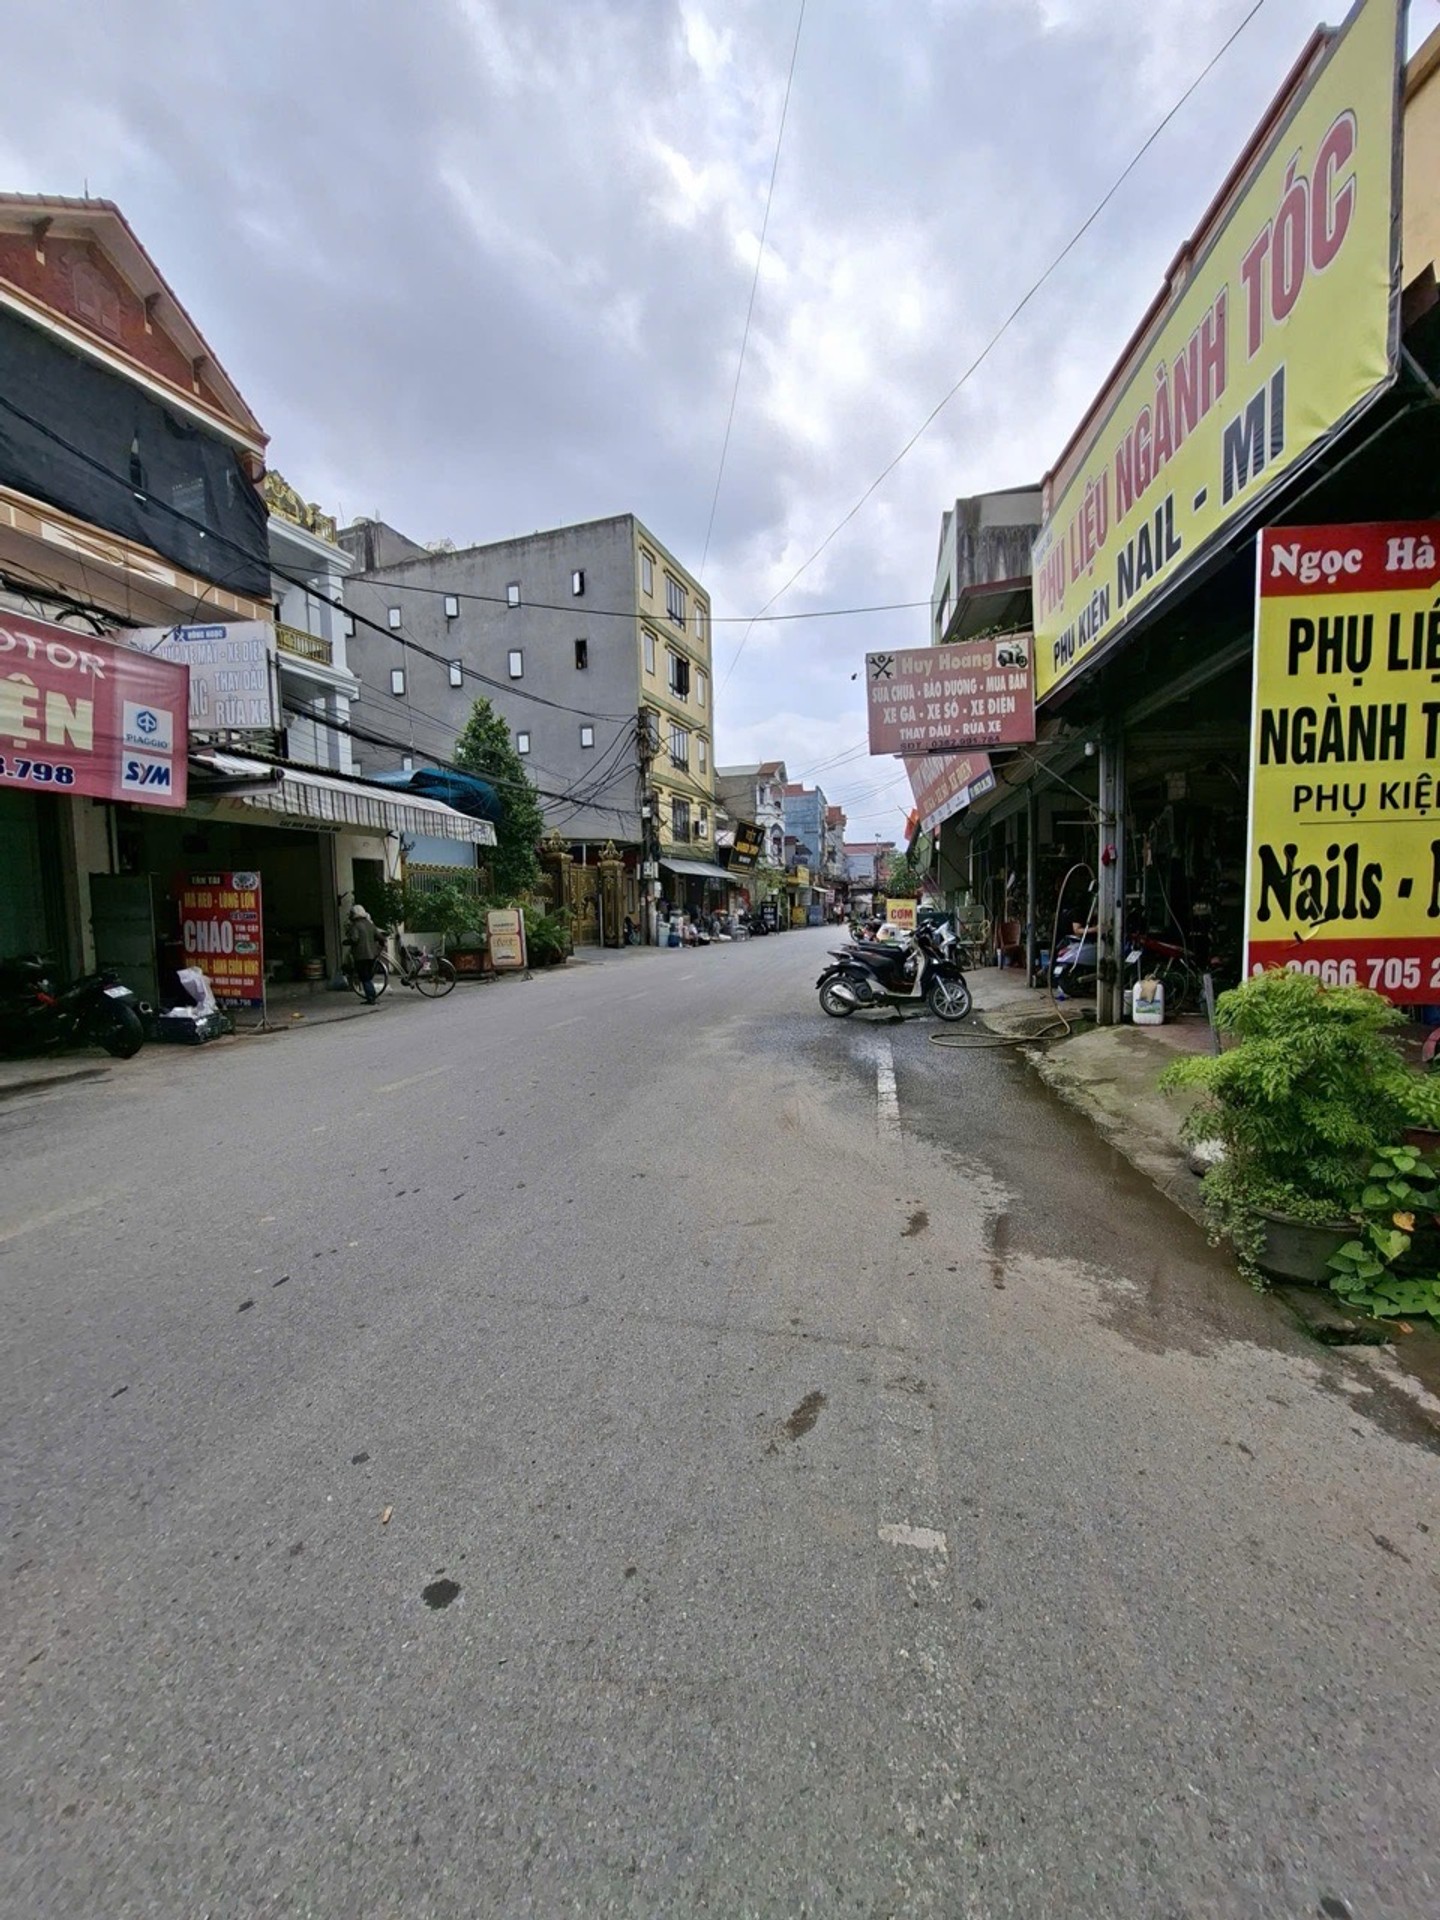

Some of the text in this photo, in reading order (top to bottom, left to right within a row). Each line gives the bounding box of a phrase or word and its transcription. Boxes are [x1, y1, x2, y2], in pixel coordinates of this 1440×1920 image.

[1039, 109, 1356, 625] PHỤ LIỆU NGÀNH TÓC
[1054, 622, 1076, 673] PHỤ
[1078, 583, 1110, 648] KIỆN
[1117, 494, 1181, 609] NAIL
[1223, 363, 1285, 505] MI
[1271, 535, 1436, 584] Ngọc Hà
[1288, 613, 1373, 686] PHỤ
[215, 671, 239, 692] THAY
[902, 657, 933, 677] Huy
[986, 675, 1006, 692] MUA
[1008, 672, 1027, 690] BÁN
[250, 699, 268, 724] XE
[883, 708, 897, 724] XE
[899, 706, 916, 722] GA
[927, 704, 941, 720] XE
[970, 700, 985, 716] XE
[988, 695, 1015, 719] ĐIỆN
[126, 734, 168, 749] PIAGGIO
[900, 726, 926, 740] THAY
[988, 720, 1002, 733] XE
[1260, 693, 1407, 766] NGÀNH
[125, 761, 170, 786] SYM
[1293, 773, 1440, 818] PHỤ KIỆ
[1257, 842, 1382, 922] Nails
[184, 915, 233, 953] CHÁO
[1366, 957, 1421, 989] 705
